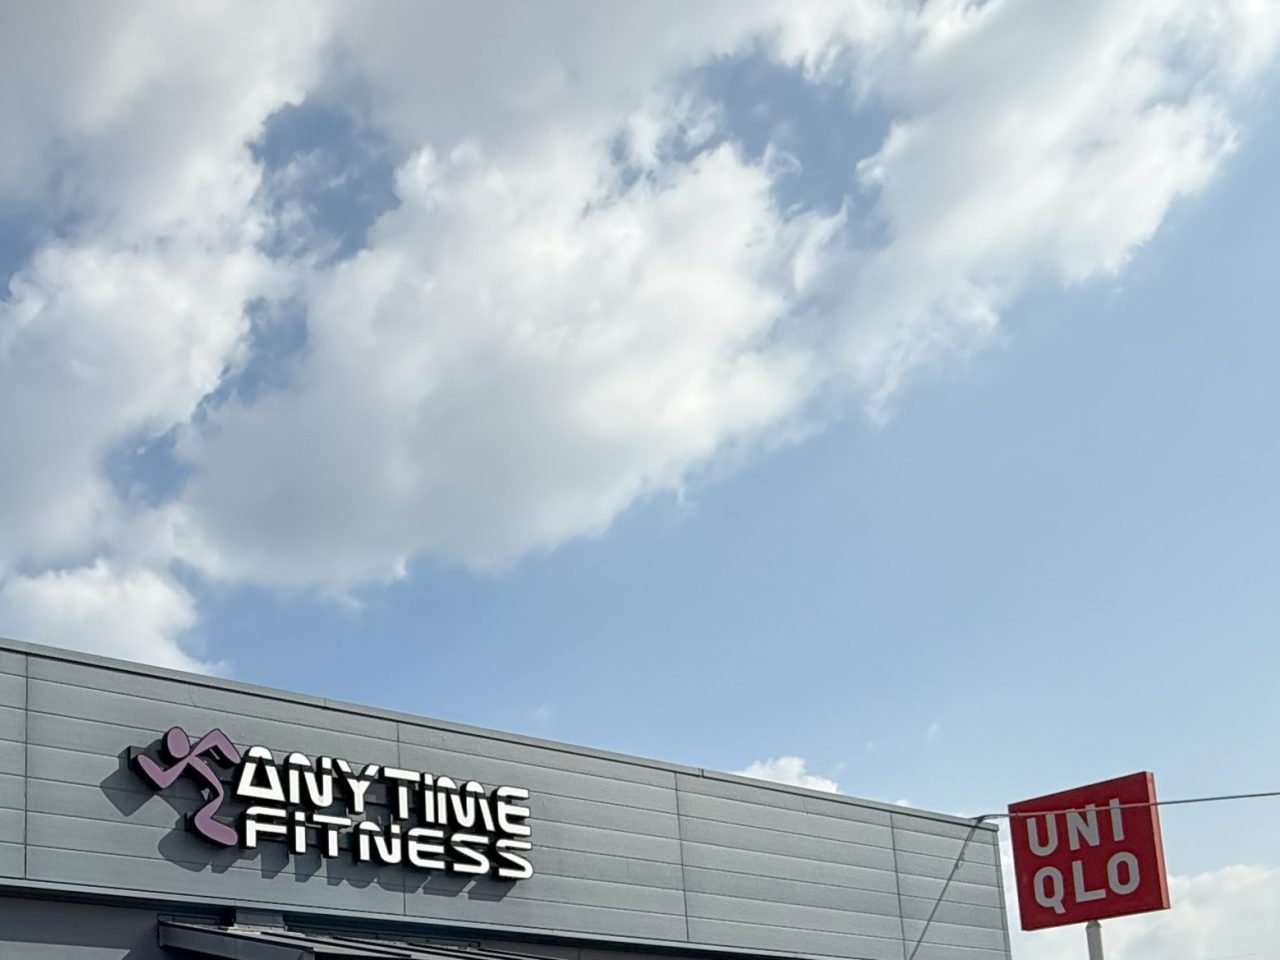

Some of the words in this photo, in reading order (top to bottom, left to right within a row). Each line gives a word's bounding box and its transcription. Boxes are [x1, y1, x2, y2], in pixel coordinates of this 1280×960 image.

[236, 745, 532, 837] ANYTIME
[245, 805, 533, 880] FITNESS
[1026, 797, 1125, 857] UNI
[1033, 851, 1141, 914] QLO
